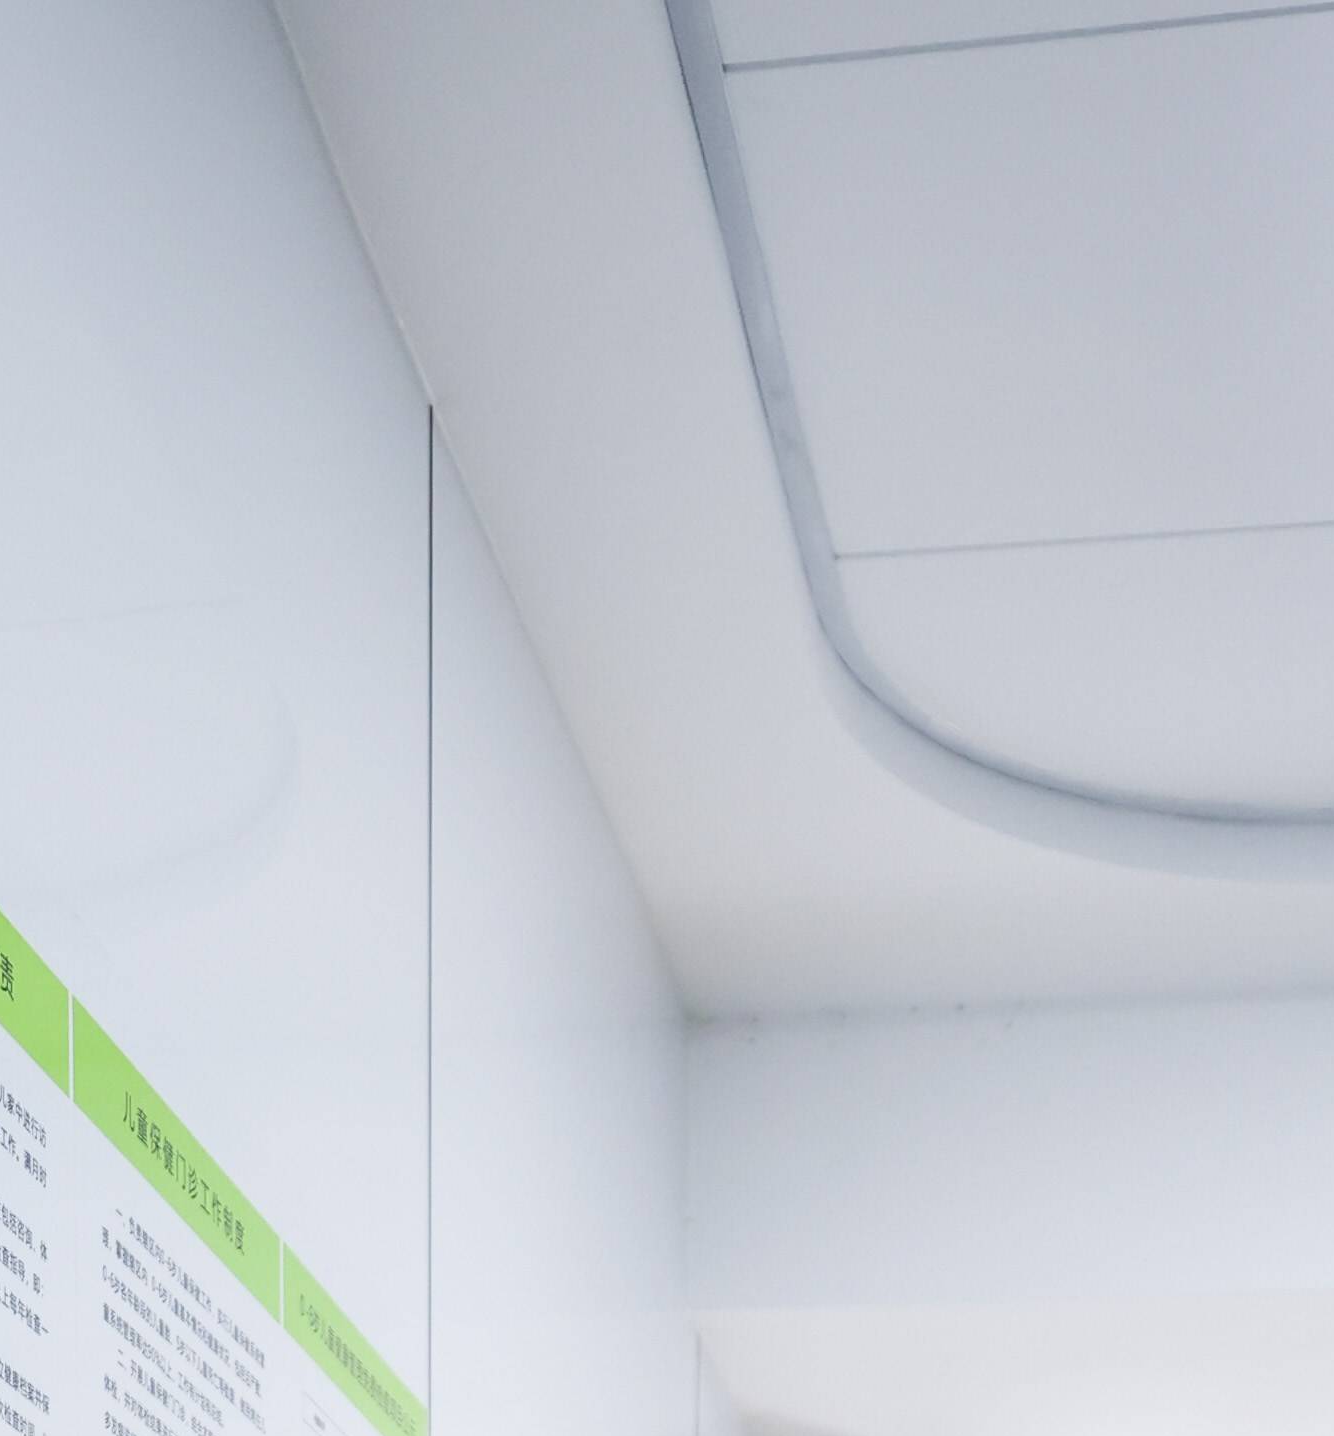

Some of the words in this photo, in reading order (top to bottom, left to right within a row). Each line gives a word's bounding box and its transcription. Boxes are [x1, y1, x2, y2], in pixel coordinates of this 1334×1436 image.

[122, 1091, 245, 1256] 儿童保健门诊工作制度
